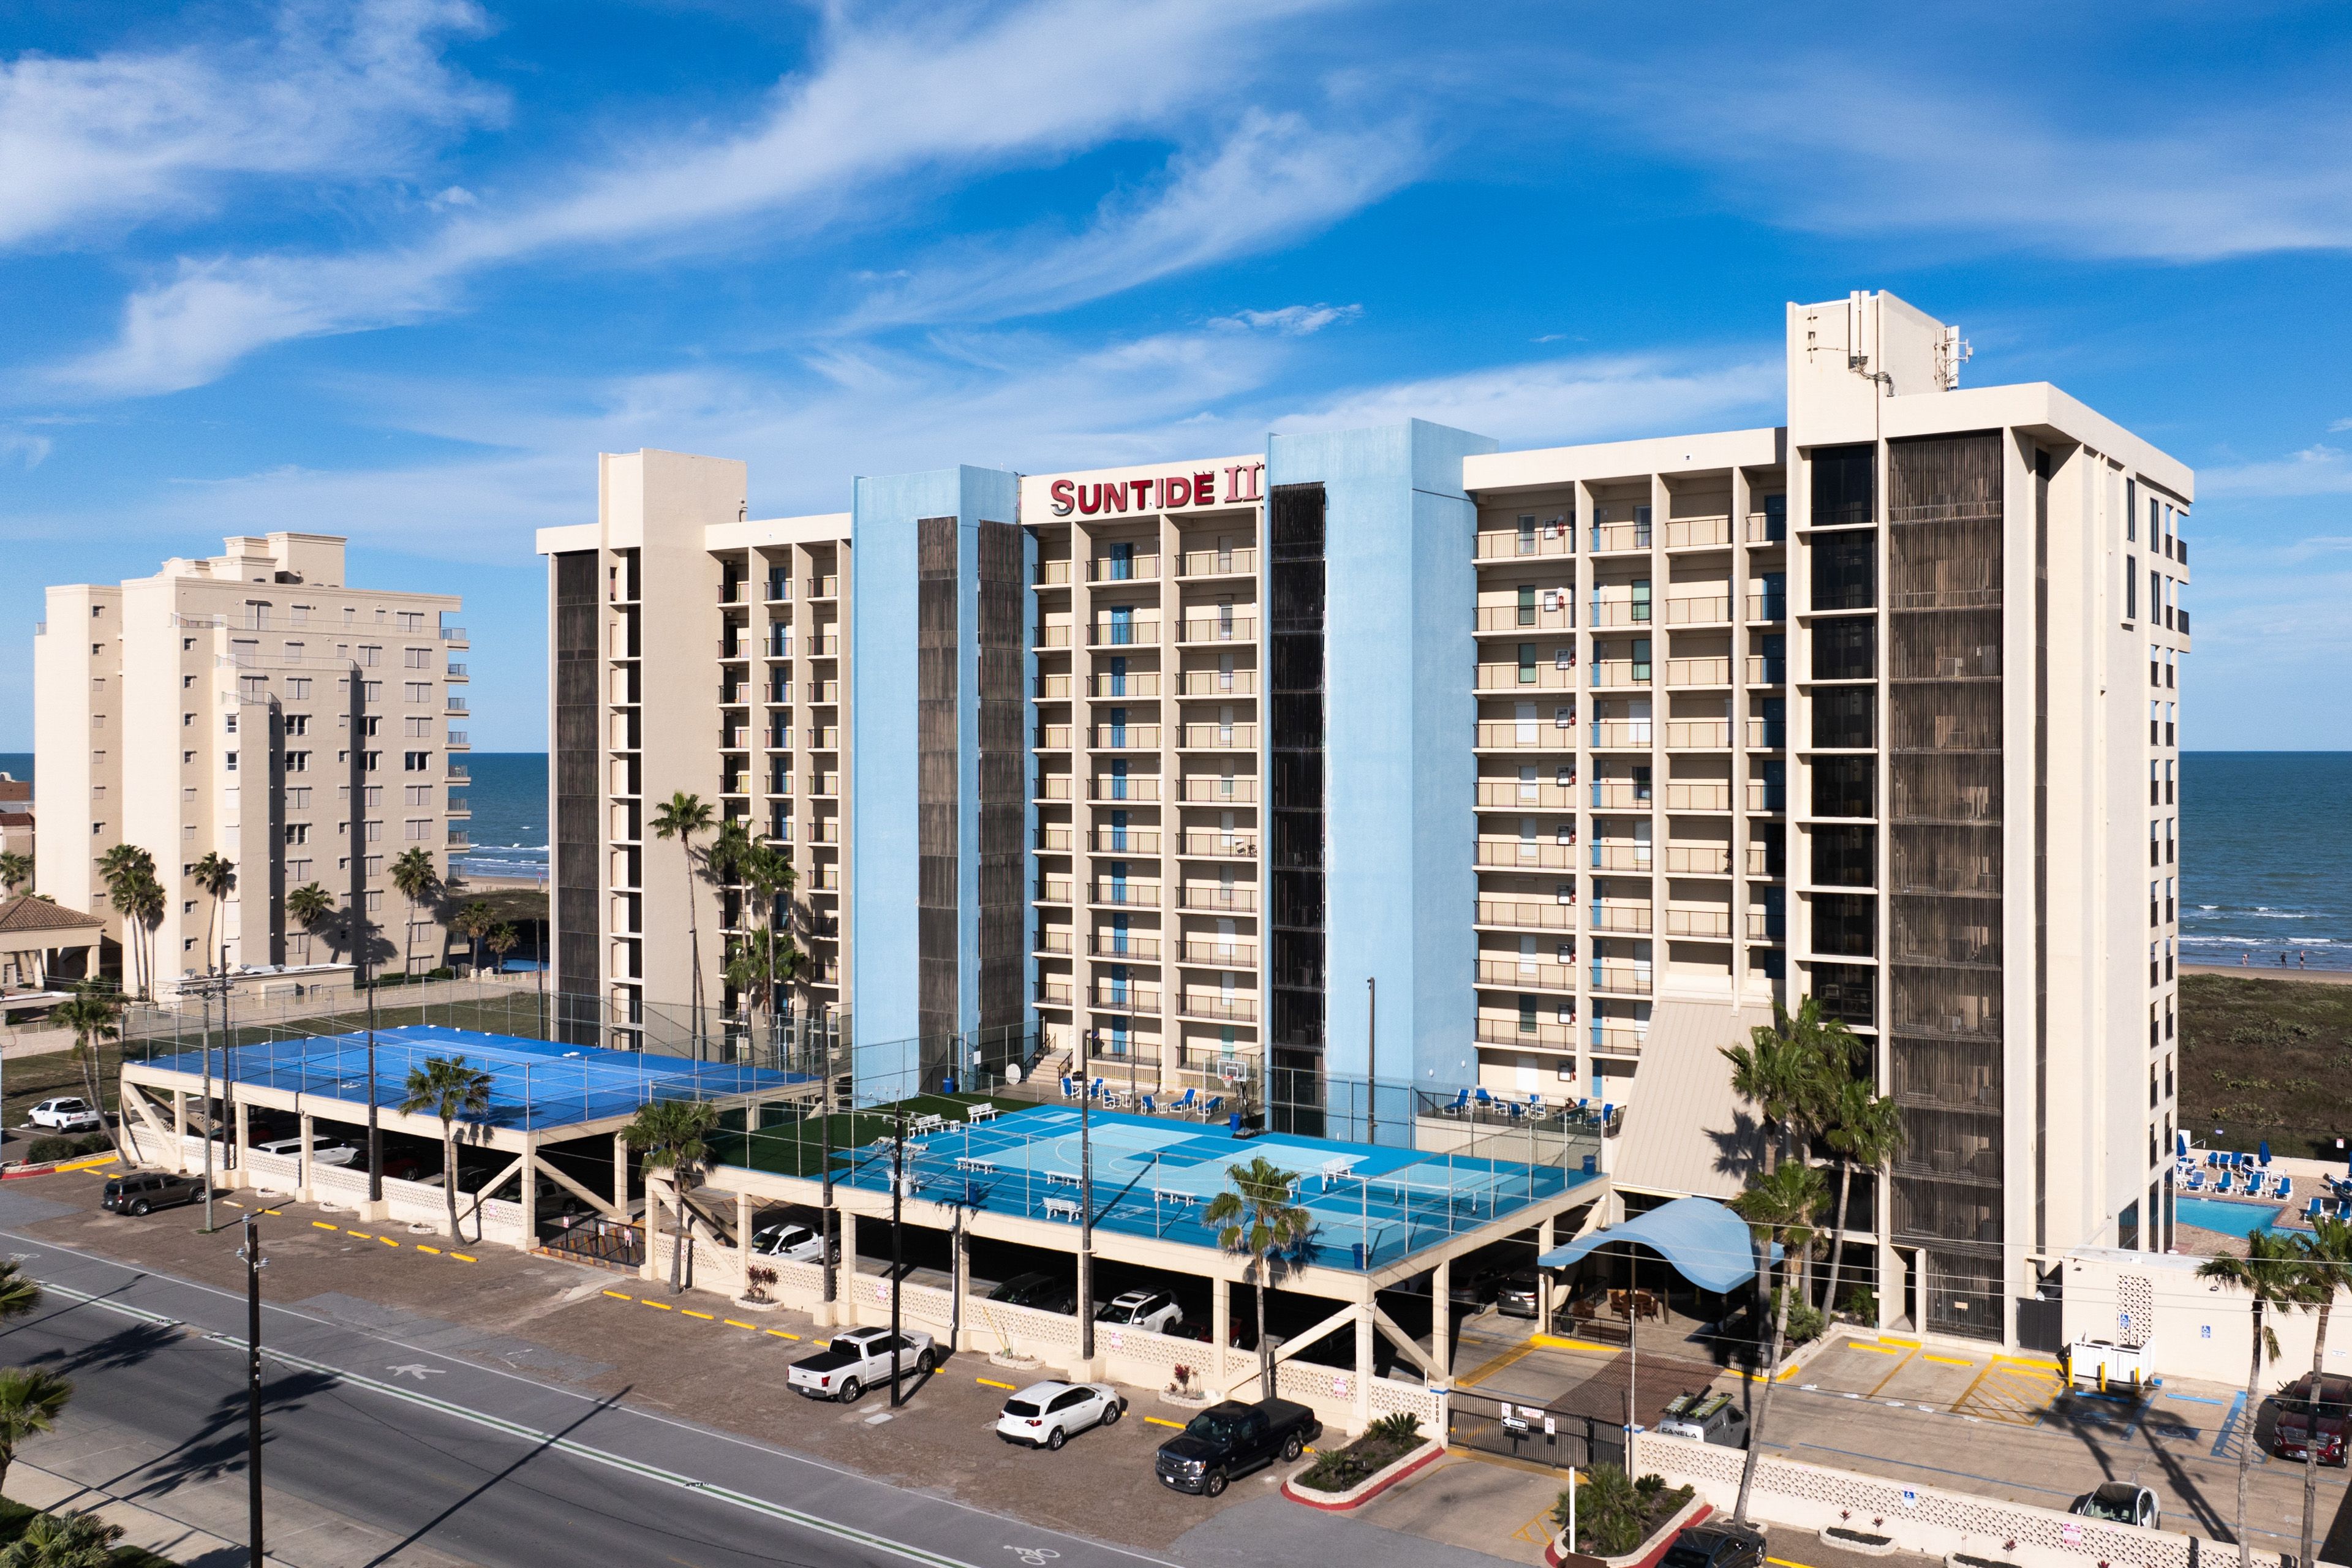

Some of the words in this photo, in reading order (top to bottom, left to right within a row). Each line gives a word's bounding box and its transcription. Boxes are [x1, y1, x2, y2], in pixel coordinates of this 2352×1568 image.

[1050, 474, 1214, 515] SUNTIDE
[1223, 464, 1265, 503] II
[1661, 1427, 1697, 1439] CANELA
[1706, 1419, 1724, 1436] CANELA
